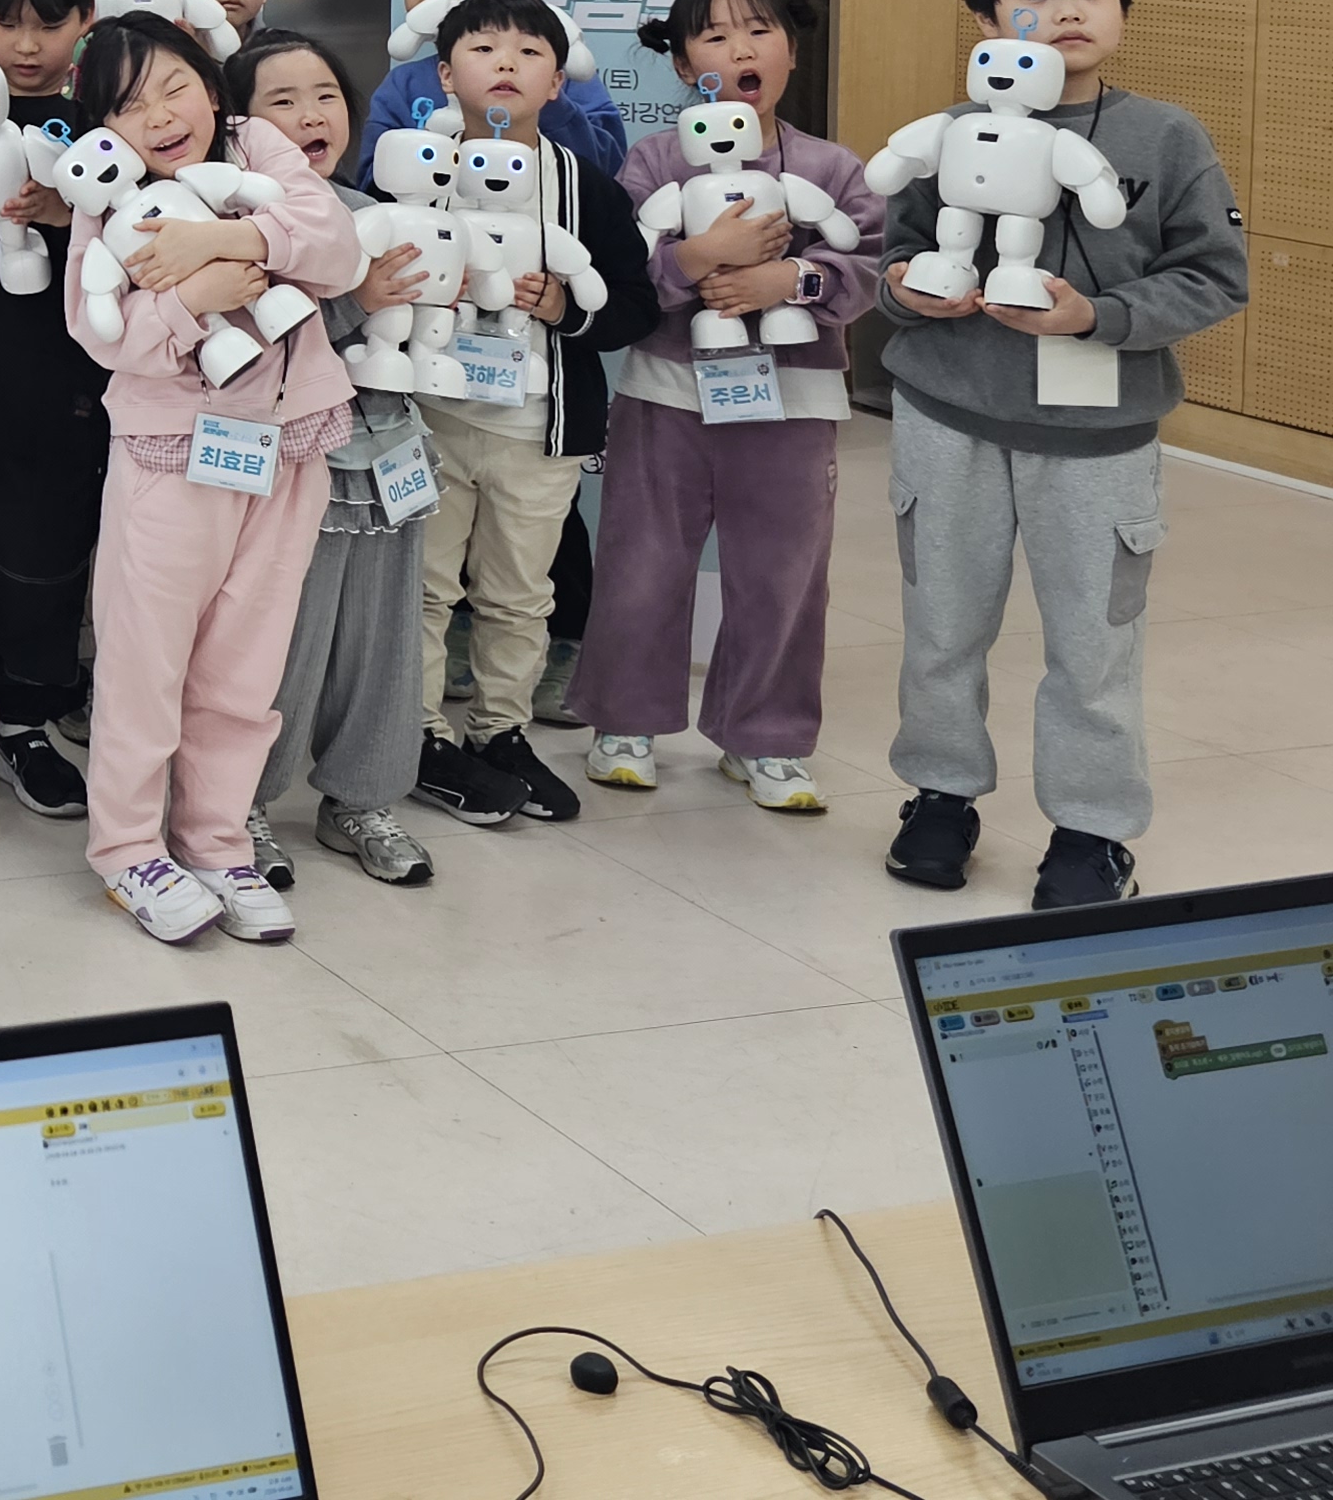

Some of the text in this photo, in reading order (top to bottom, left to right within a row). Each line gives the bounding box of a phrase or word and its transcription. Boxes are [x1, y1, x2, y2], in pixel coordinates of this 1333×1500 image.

[595, 67, 640, 91] (토)
[709, 382, 772, 407] 주은서
[199, 445, 266, 476] 최효담
[388, 467, 428, 503] 이소담
